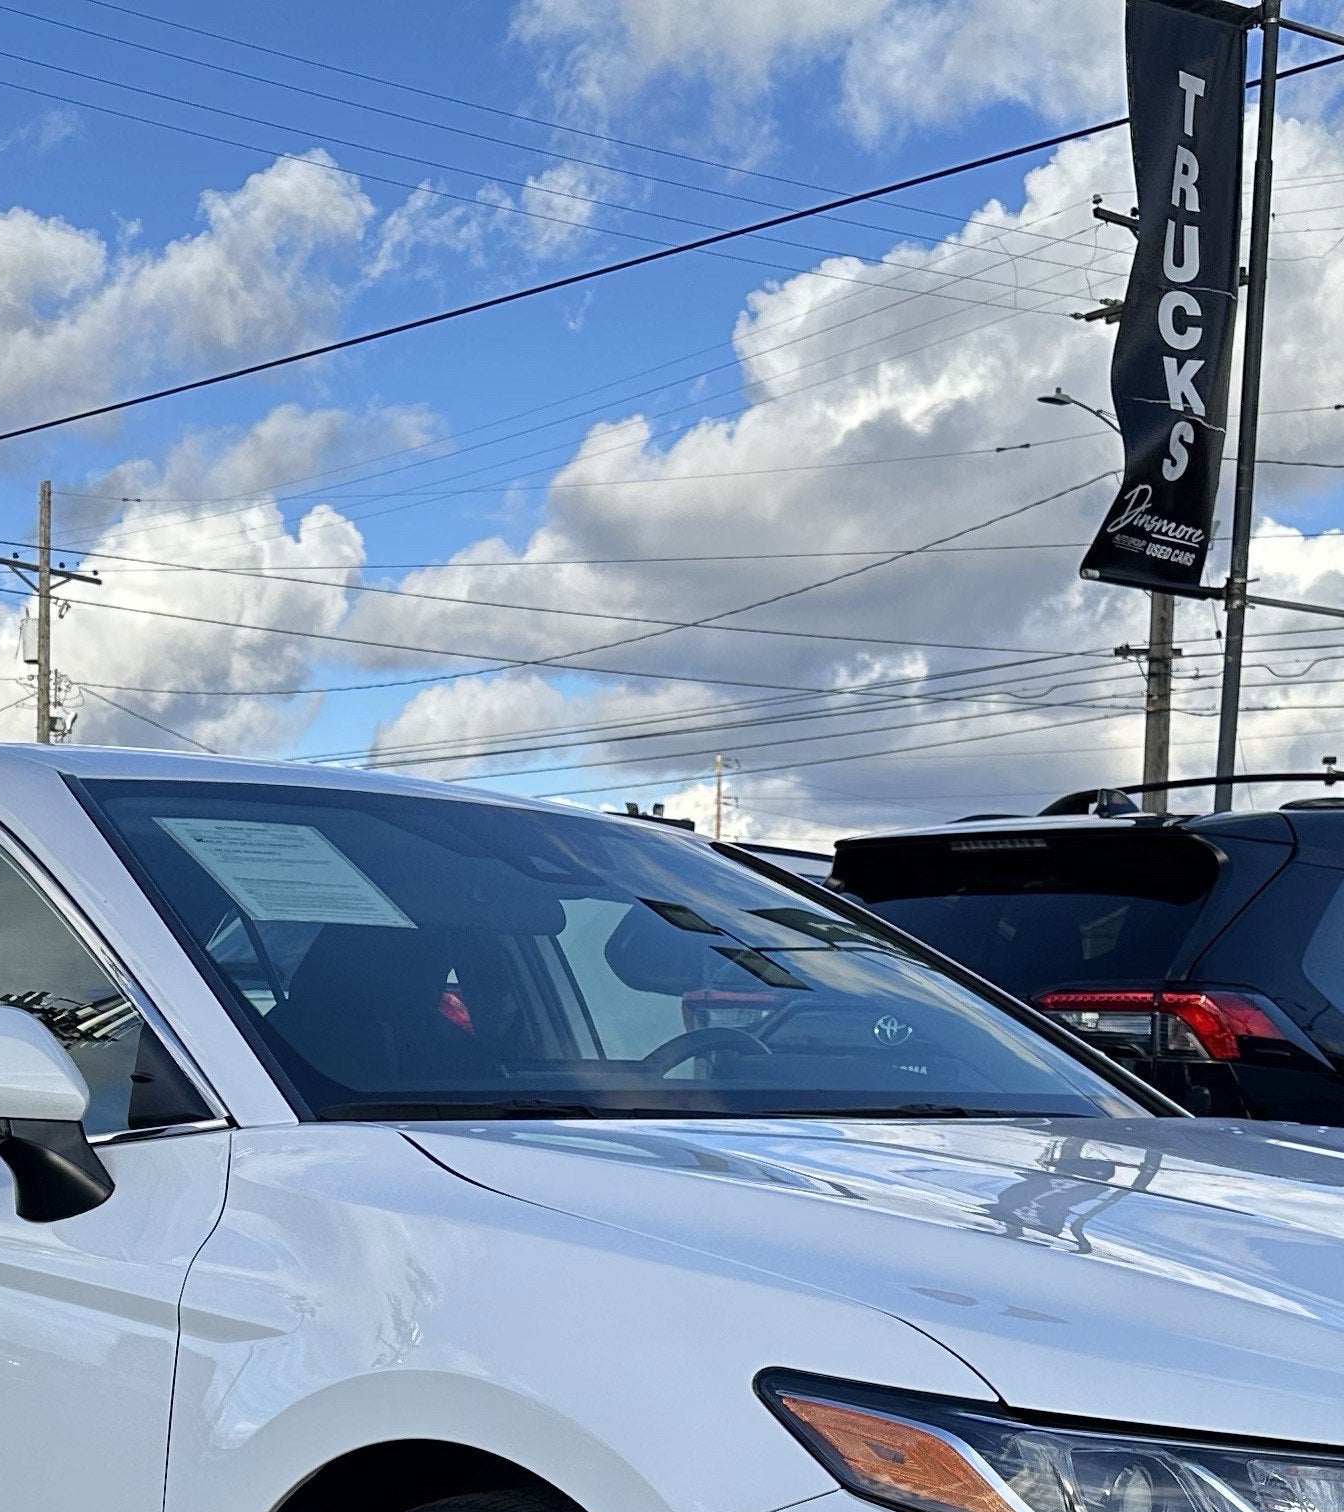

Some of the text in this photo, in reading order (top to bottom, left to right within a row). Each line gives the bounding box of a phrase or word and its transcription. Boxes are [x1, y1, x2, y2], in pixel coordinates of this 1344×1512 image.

[1157, 70, 1206, 482] TRUCKS
[1106, 483, 1205, 543] Dinsmore
[1146, 543, 1173, 560] USED
